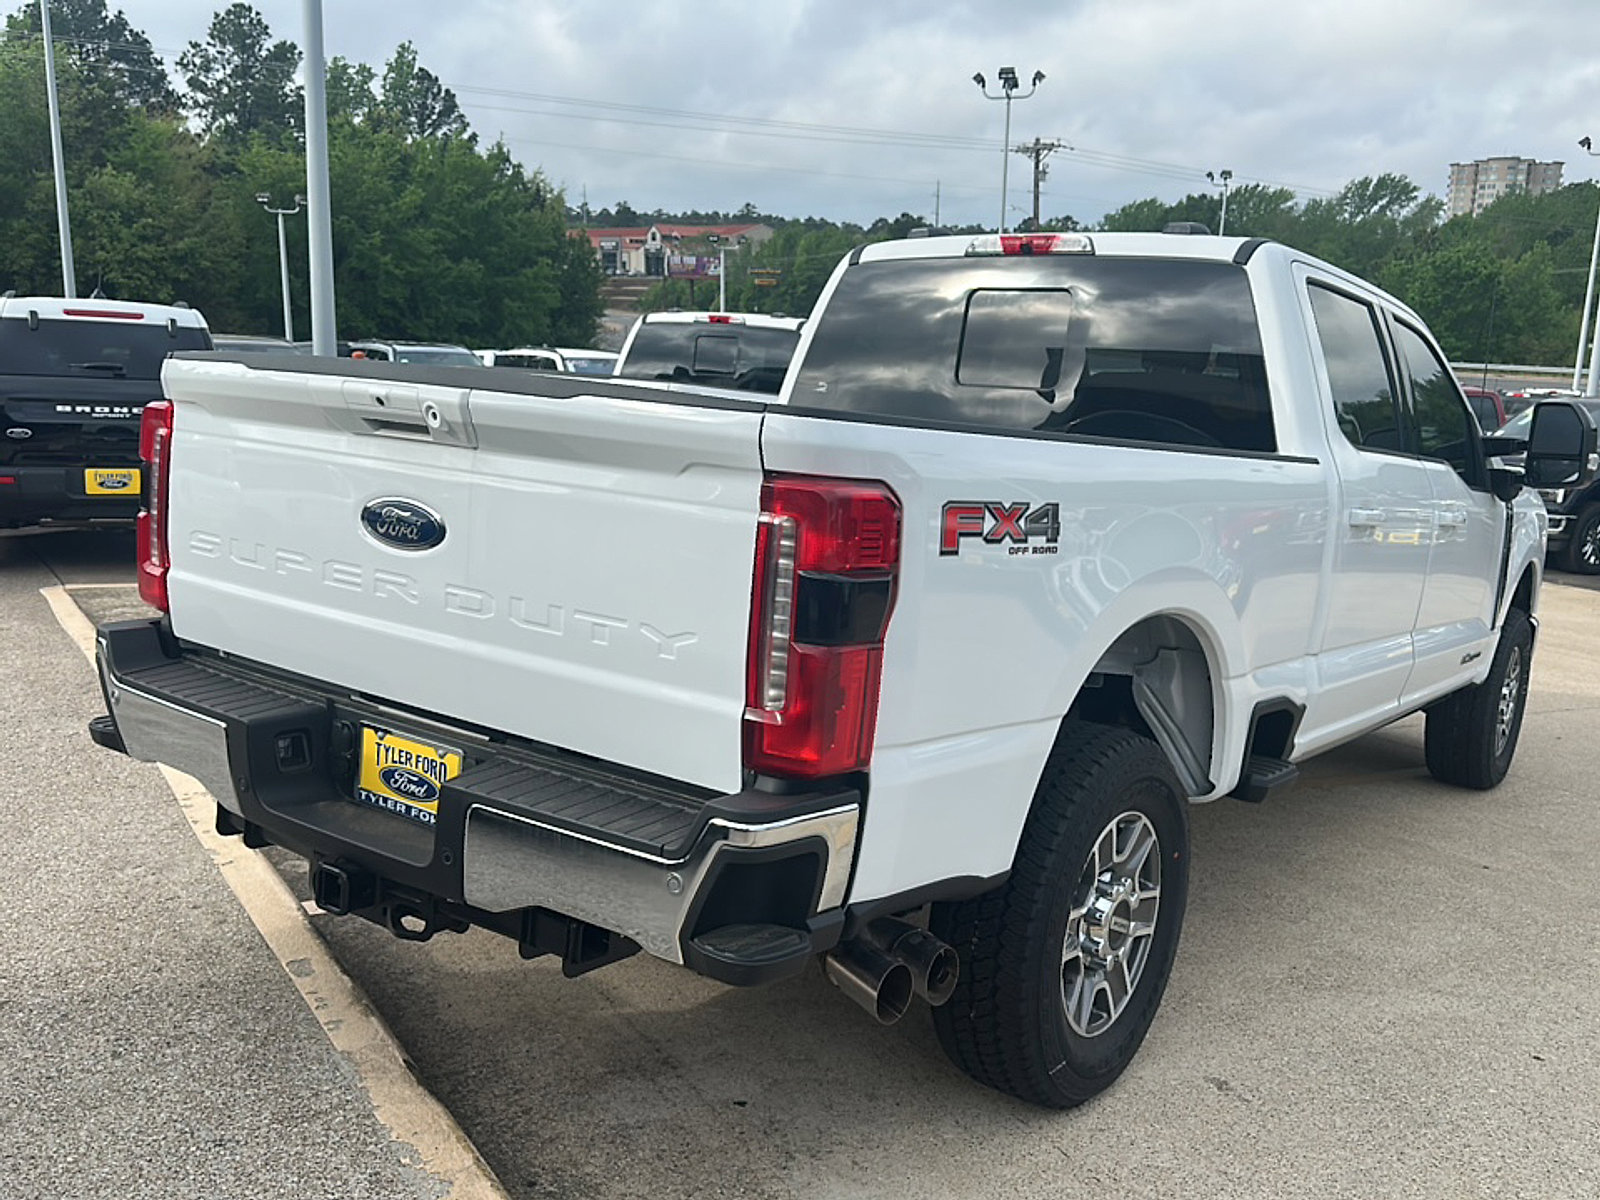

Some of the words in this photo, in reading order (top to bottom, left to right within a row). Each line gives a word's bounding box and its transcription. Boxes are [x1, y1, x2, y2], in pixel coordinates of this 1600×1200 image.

[377, 506, 422, 540] Ford
[939, 500, 1060, 556] FX4
[1008, 546, 1029, 555] OFF
[1032, 546, 1058, 554] ROAD
[187, 529, 419, 605] SUPER
[444, 583, 699, 660] DUTY
[375, 742, 413, 768] TYLER
[415, 755, 447, 782] FORD
[390, 770, 428, 797] Ford
[359, 790, 405, 814] TYLER
